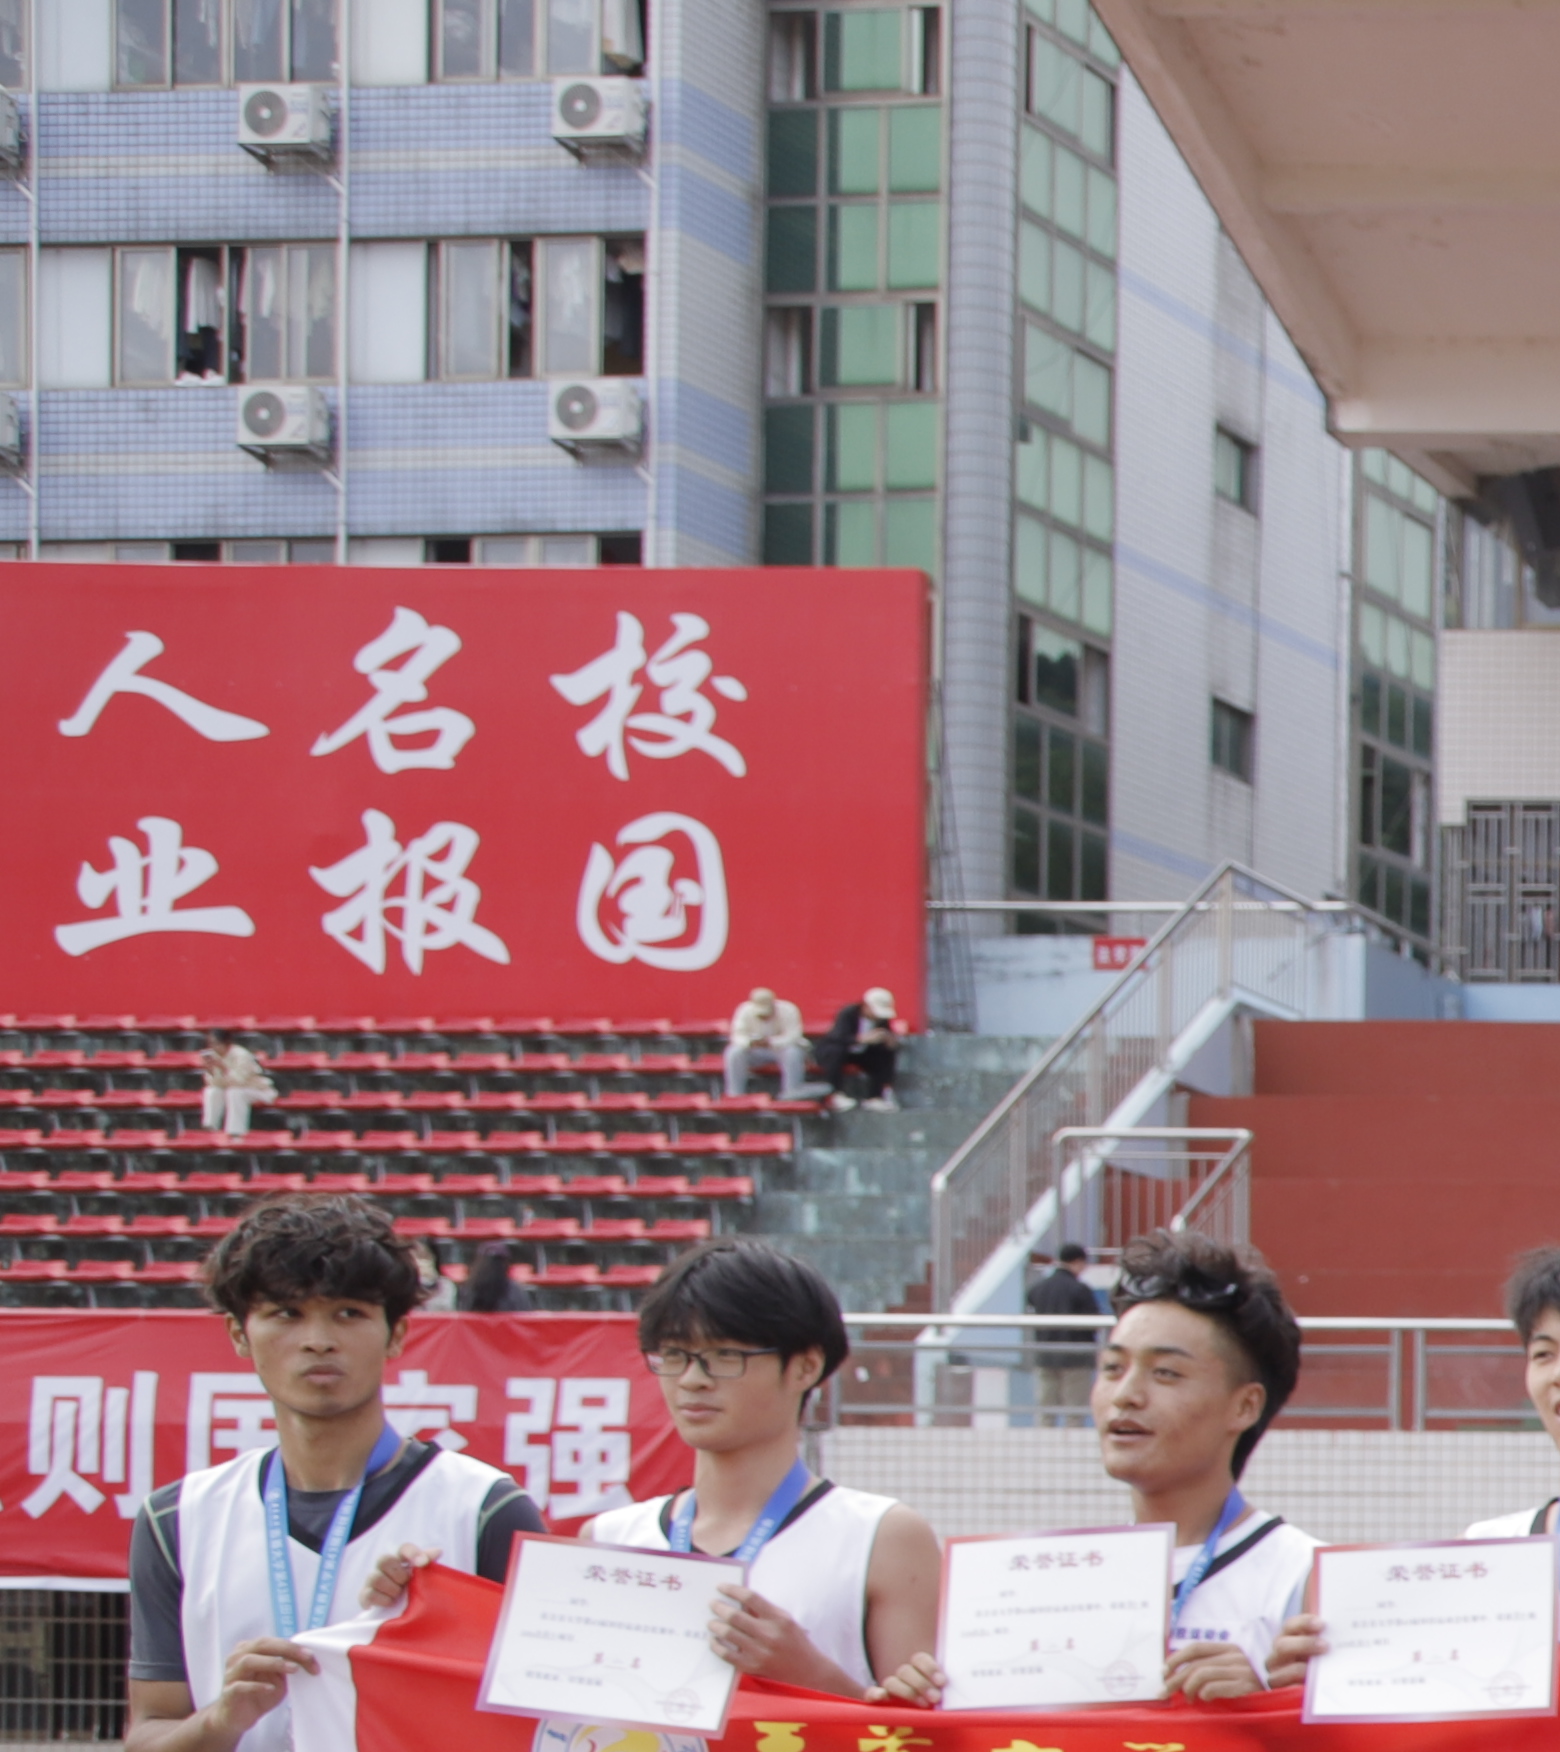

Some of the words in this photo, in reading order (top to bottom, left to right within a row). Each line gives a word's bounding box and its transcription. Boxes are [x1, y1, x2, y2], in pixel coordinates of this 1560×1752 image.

[58, 605, 748, 780] 人名校
[55, 809, 729, 975] 业报国
